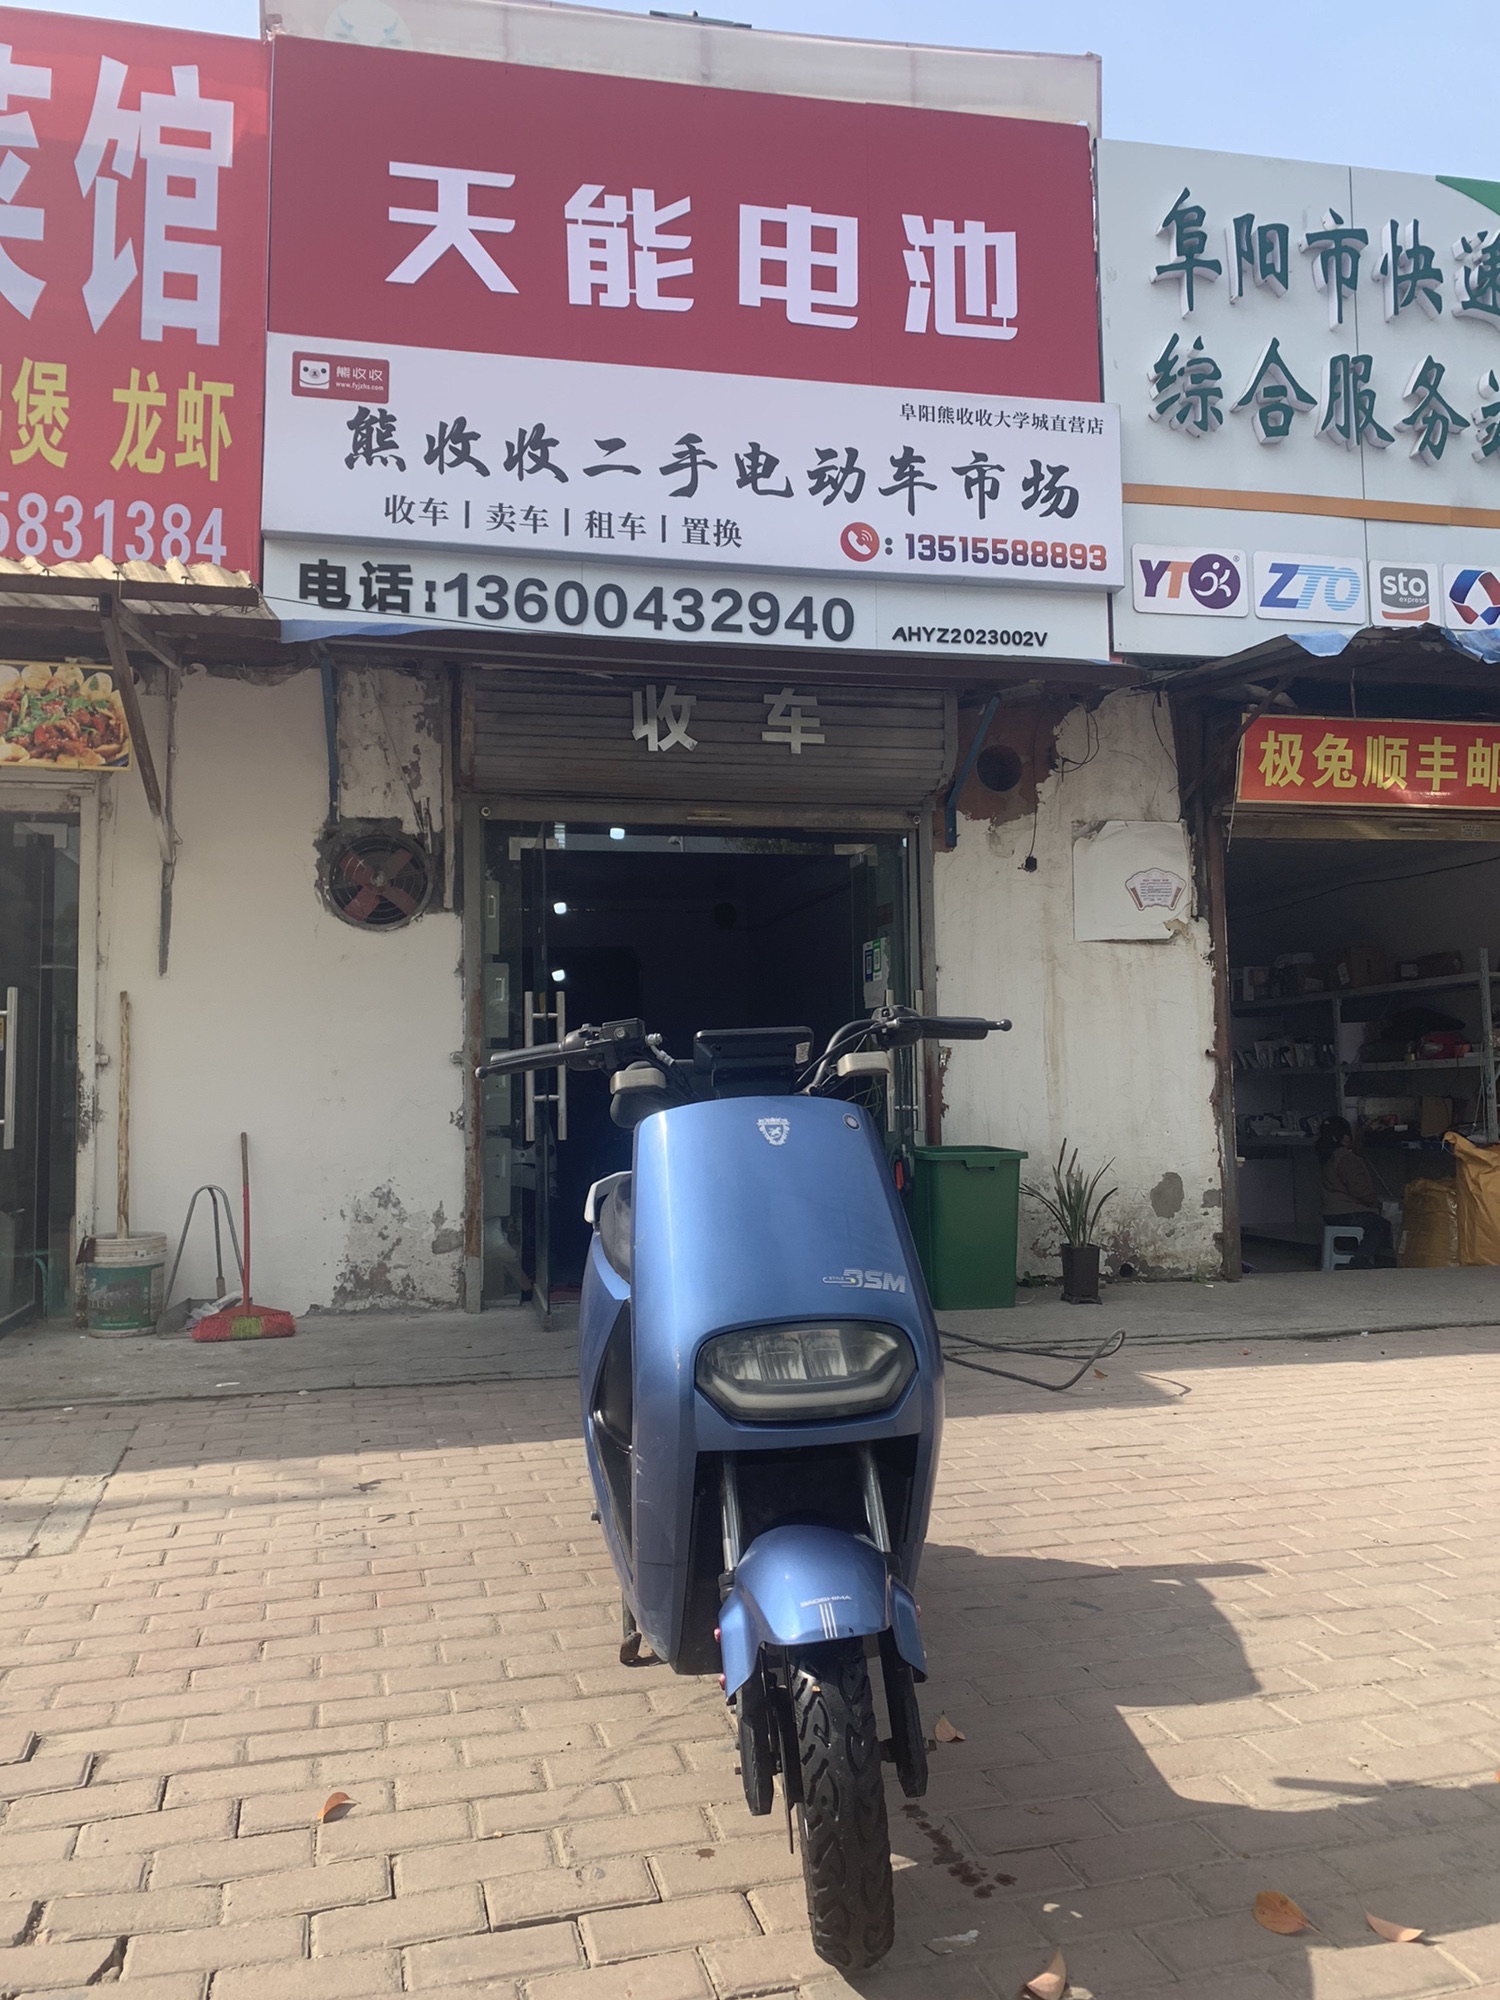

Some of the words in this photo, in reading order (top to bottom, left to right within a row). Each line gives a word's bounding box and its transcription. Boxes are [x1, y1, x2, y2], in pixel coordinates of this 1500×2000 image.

[385, 160, 1020, 341] 天能电池
[1150, 187, 1500, 331] 阜阳市快递
[336, 365, 383, 381] 熊收收
[0, 356, 70, 469] 煲
[109, 366, 235, 482] 龙虾
[899, 403, 1104, 435] 阜阳熊收收大学城直营店
[343, 405, 1080, 520] 熊收收二手电动车市场
[1259, 562, 1361, 612] ZTO
[1383, 572, 1427, 598] sto
[1398, 596, 1428, 605] express
[891, 626, 1048, 648] AHYZ2023002V
